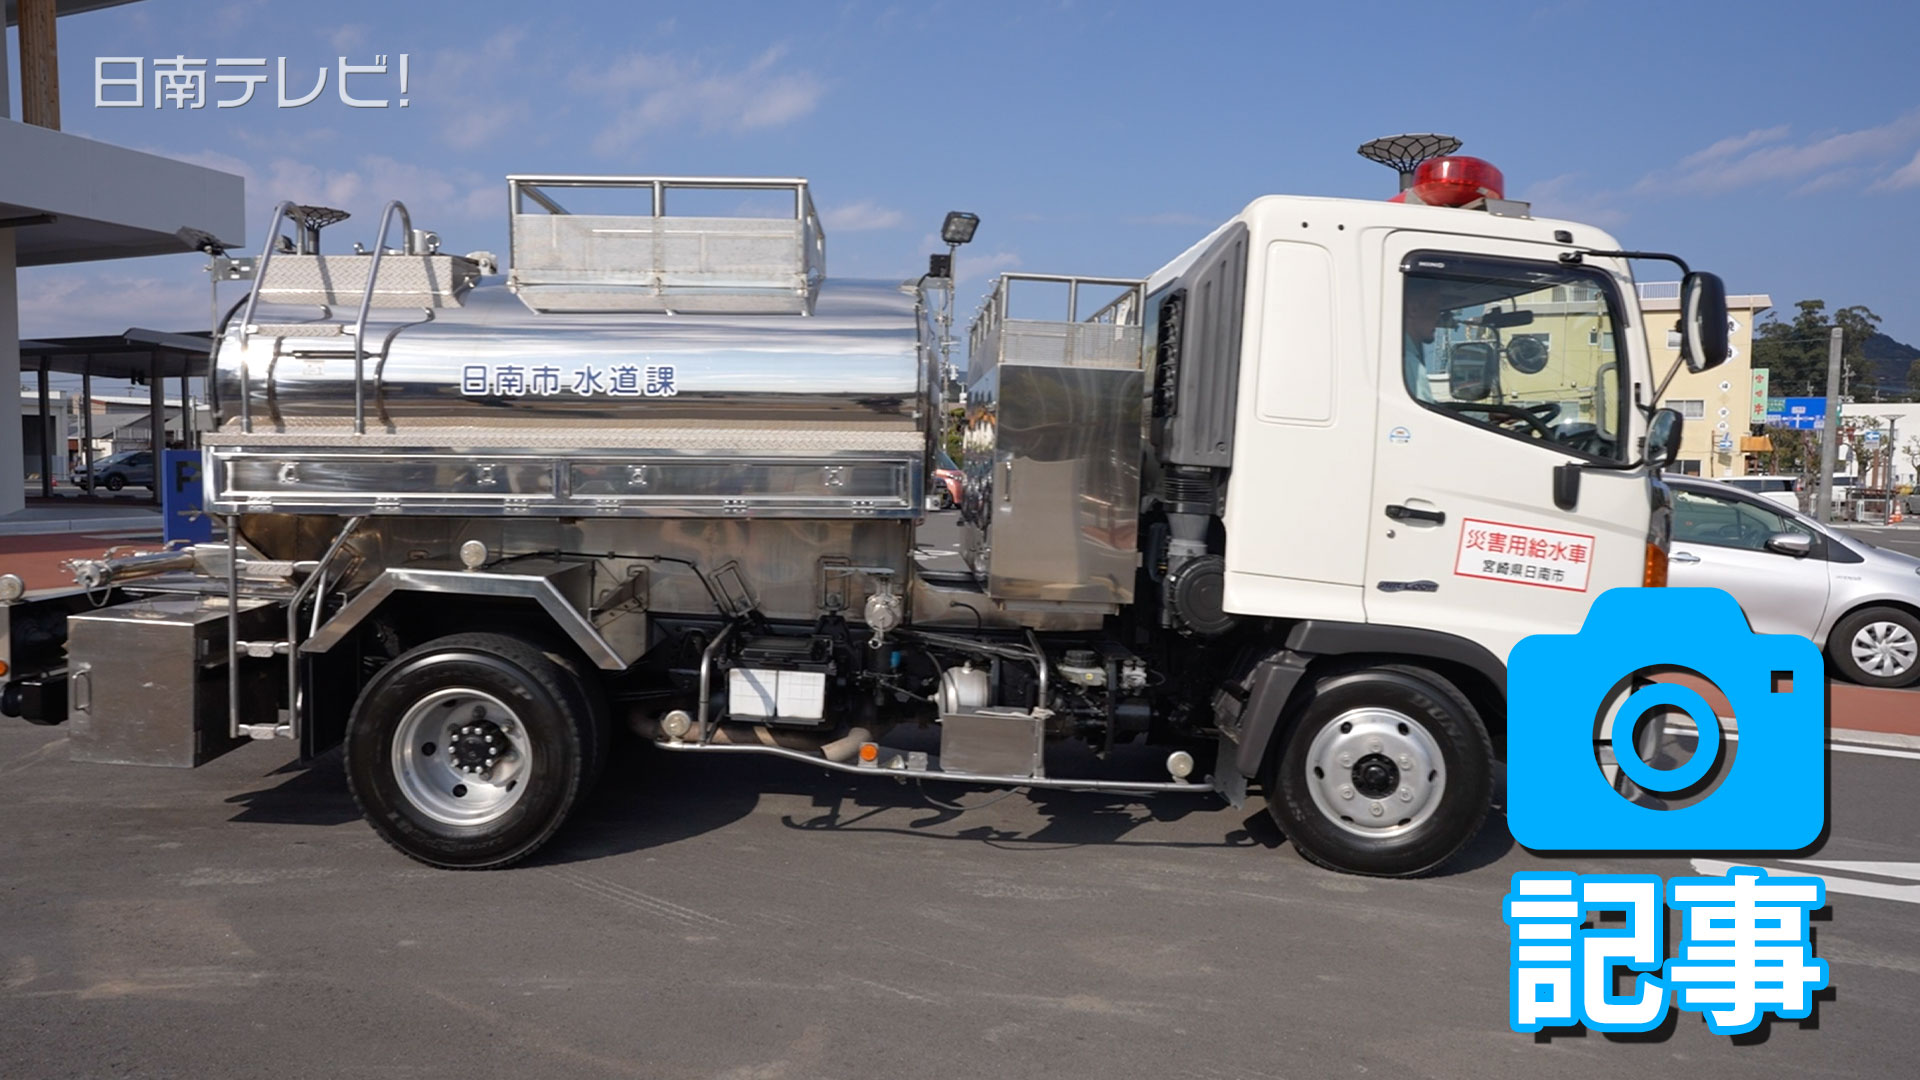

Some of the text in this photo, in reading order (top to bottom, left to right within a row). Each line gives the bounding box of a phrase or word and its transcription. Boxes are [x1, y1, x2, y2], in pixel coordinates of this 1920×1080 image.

[462, 364, 676, 394] 日南市 水道課
[1465, 529, 1587, 564] 災害用給水車
[1482, 559, 1566, 583] 宮崎県日南市
